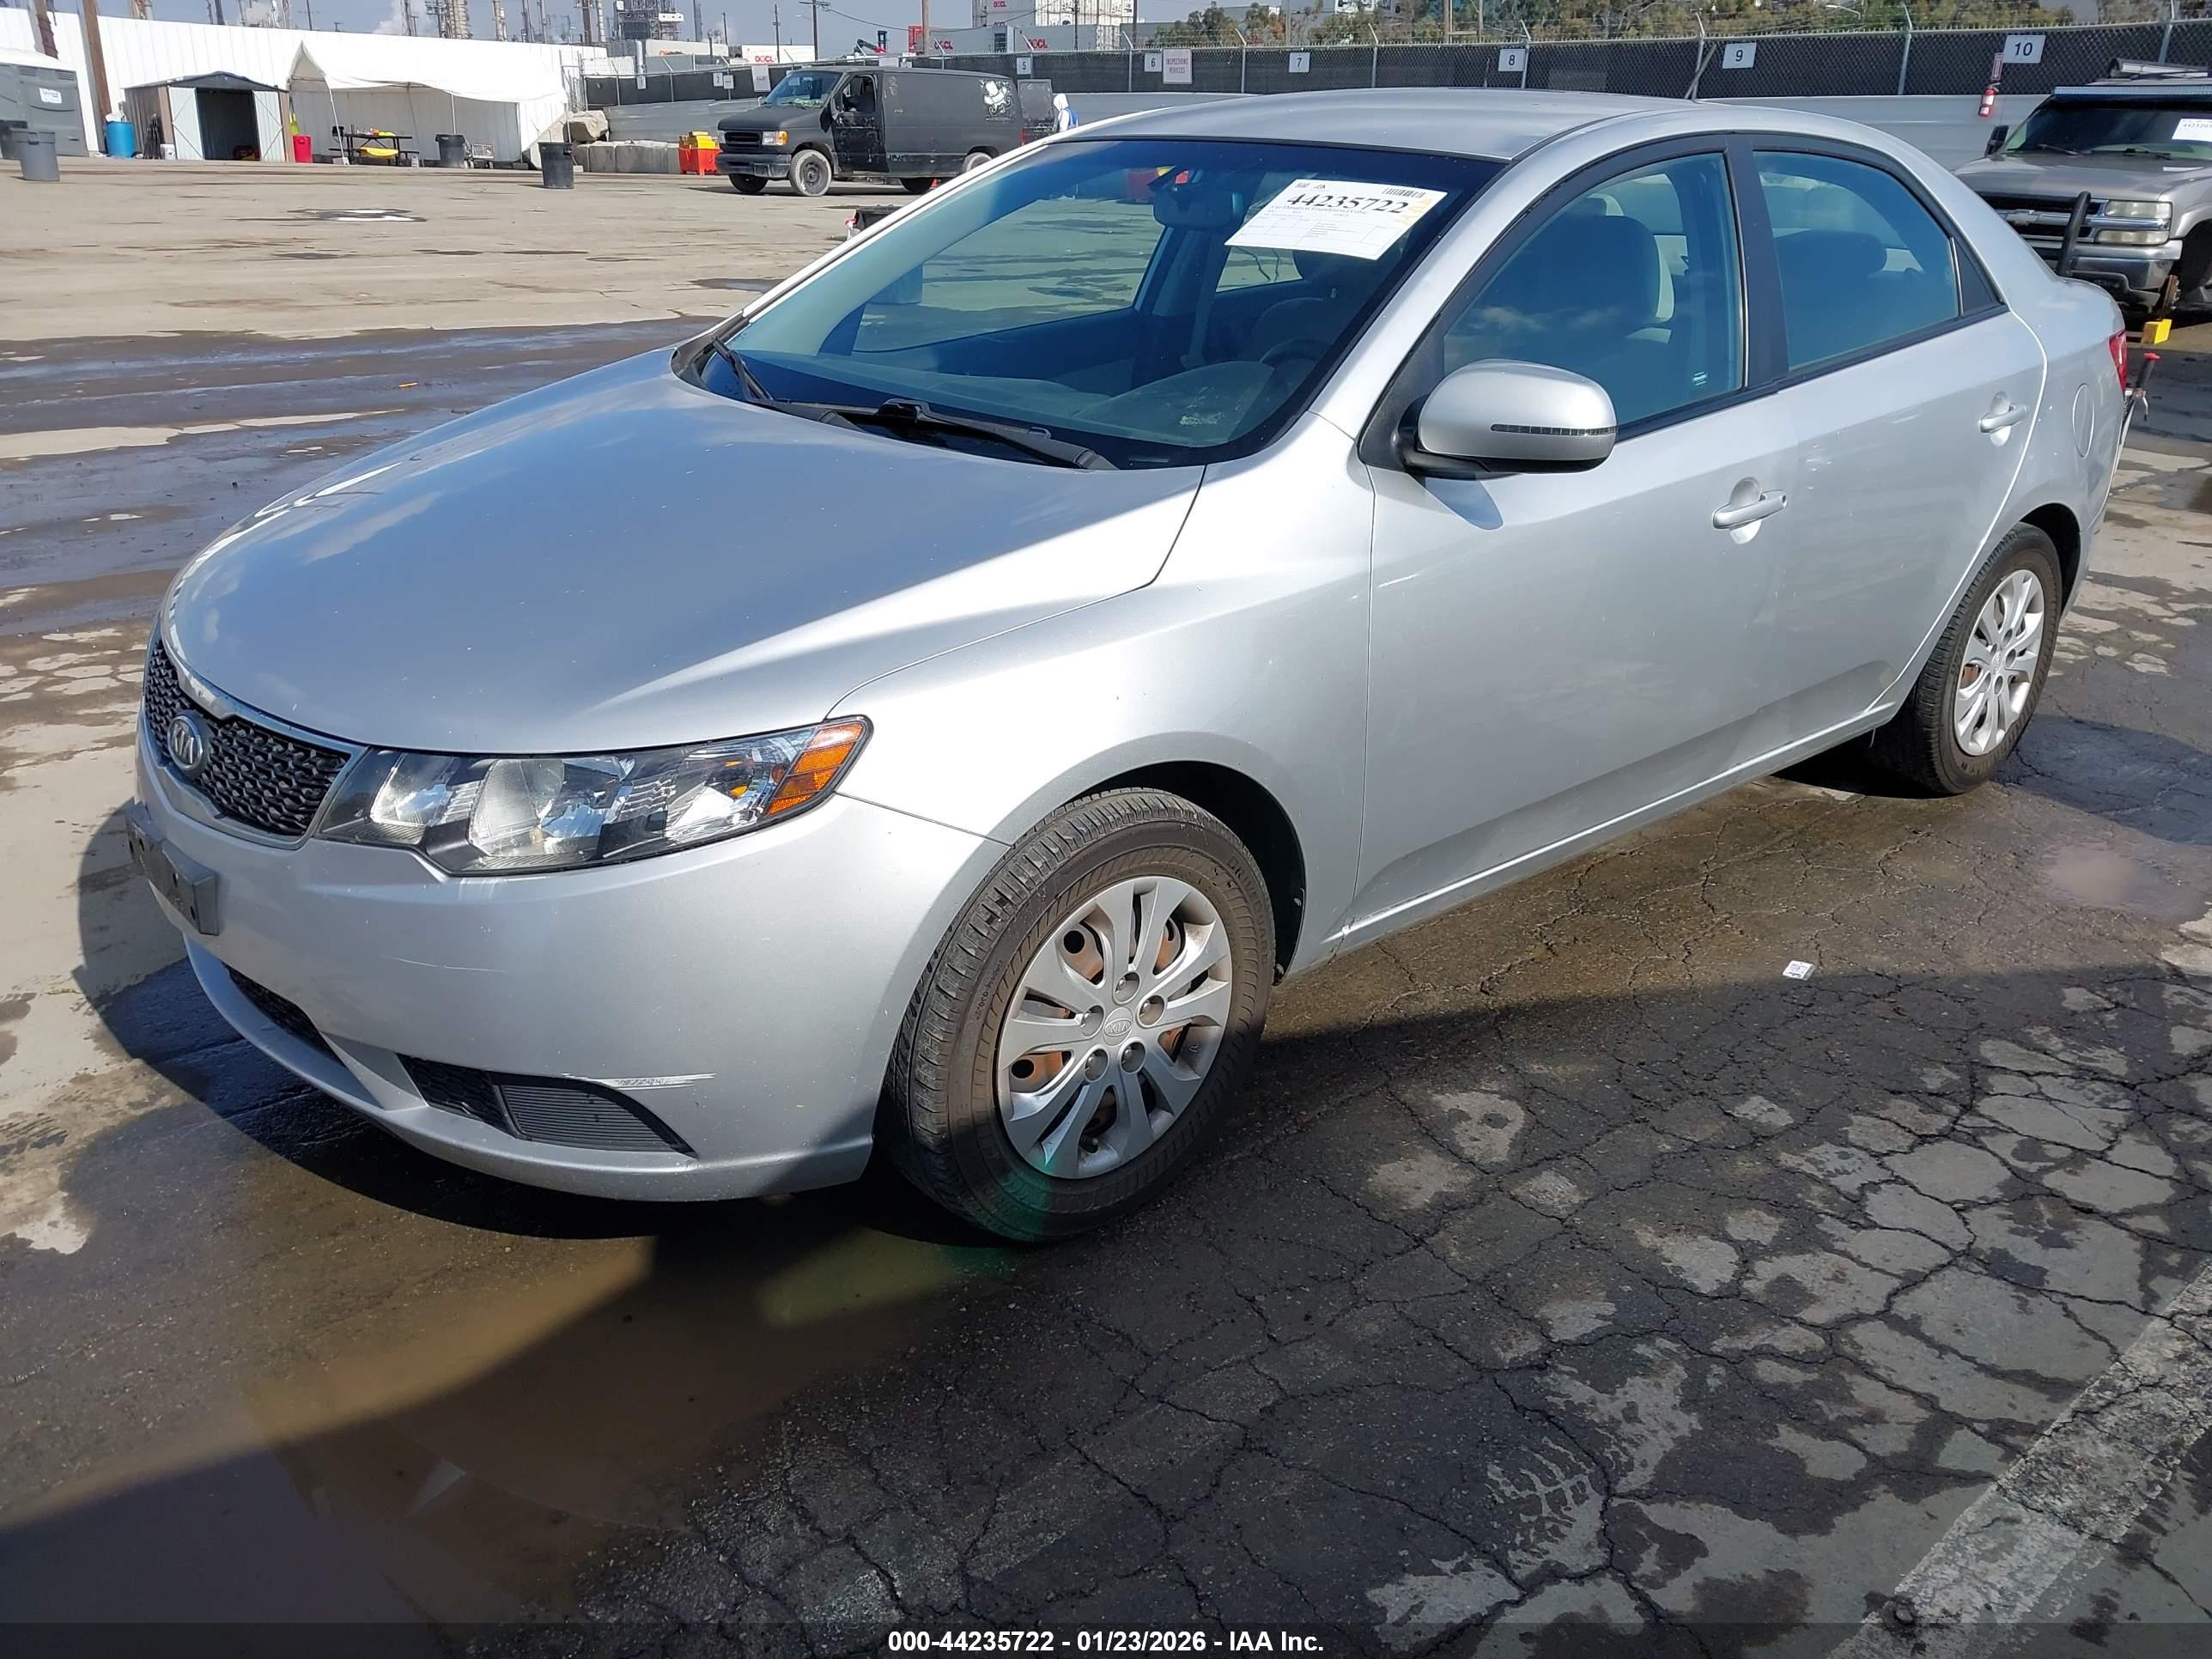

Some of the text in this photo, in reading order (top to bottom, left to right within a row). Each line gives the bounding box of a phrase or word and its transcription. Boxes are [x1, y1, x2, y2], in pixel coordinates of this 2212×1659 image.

[2014, 42, 2033, 57] 10
[1509, 54, 1516, 66] 8
[1735, 49, 1743, 63] 9
[1022, 61, 1027, 70] 5
[1151, 58, 1156, 68] 6
[1297, 58, 1302, 68] 7
[1287, 193, 1409, 214] 44235722
[1107, 1021, 1129, 1034] KIA
